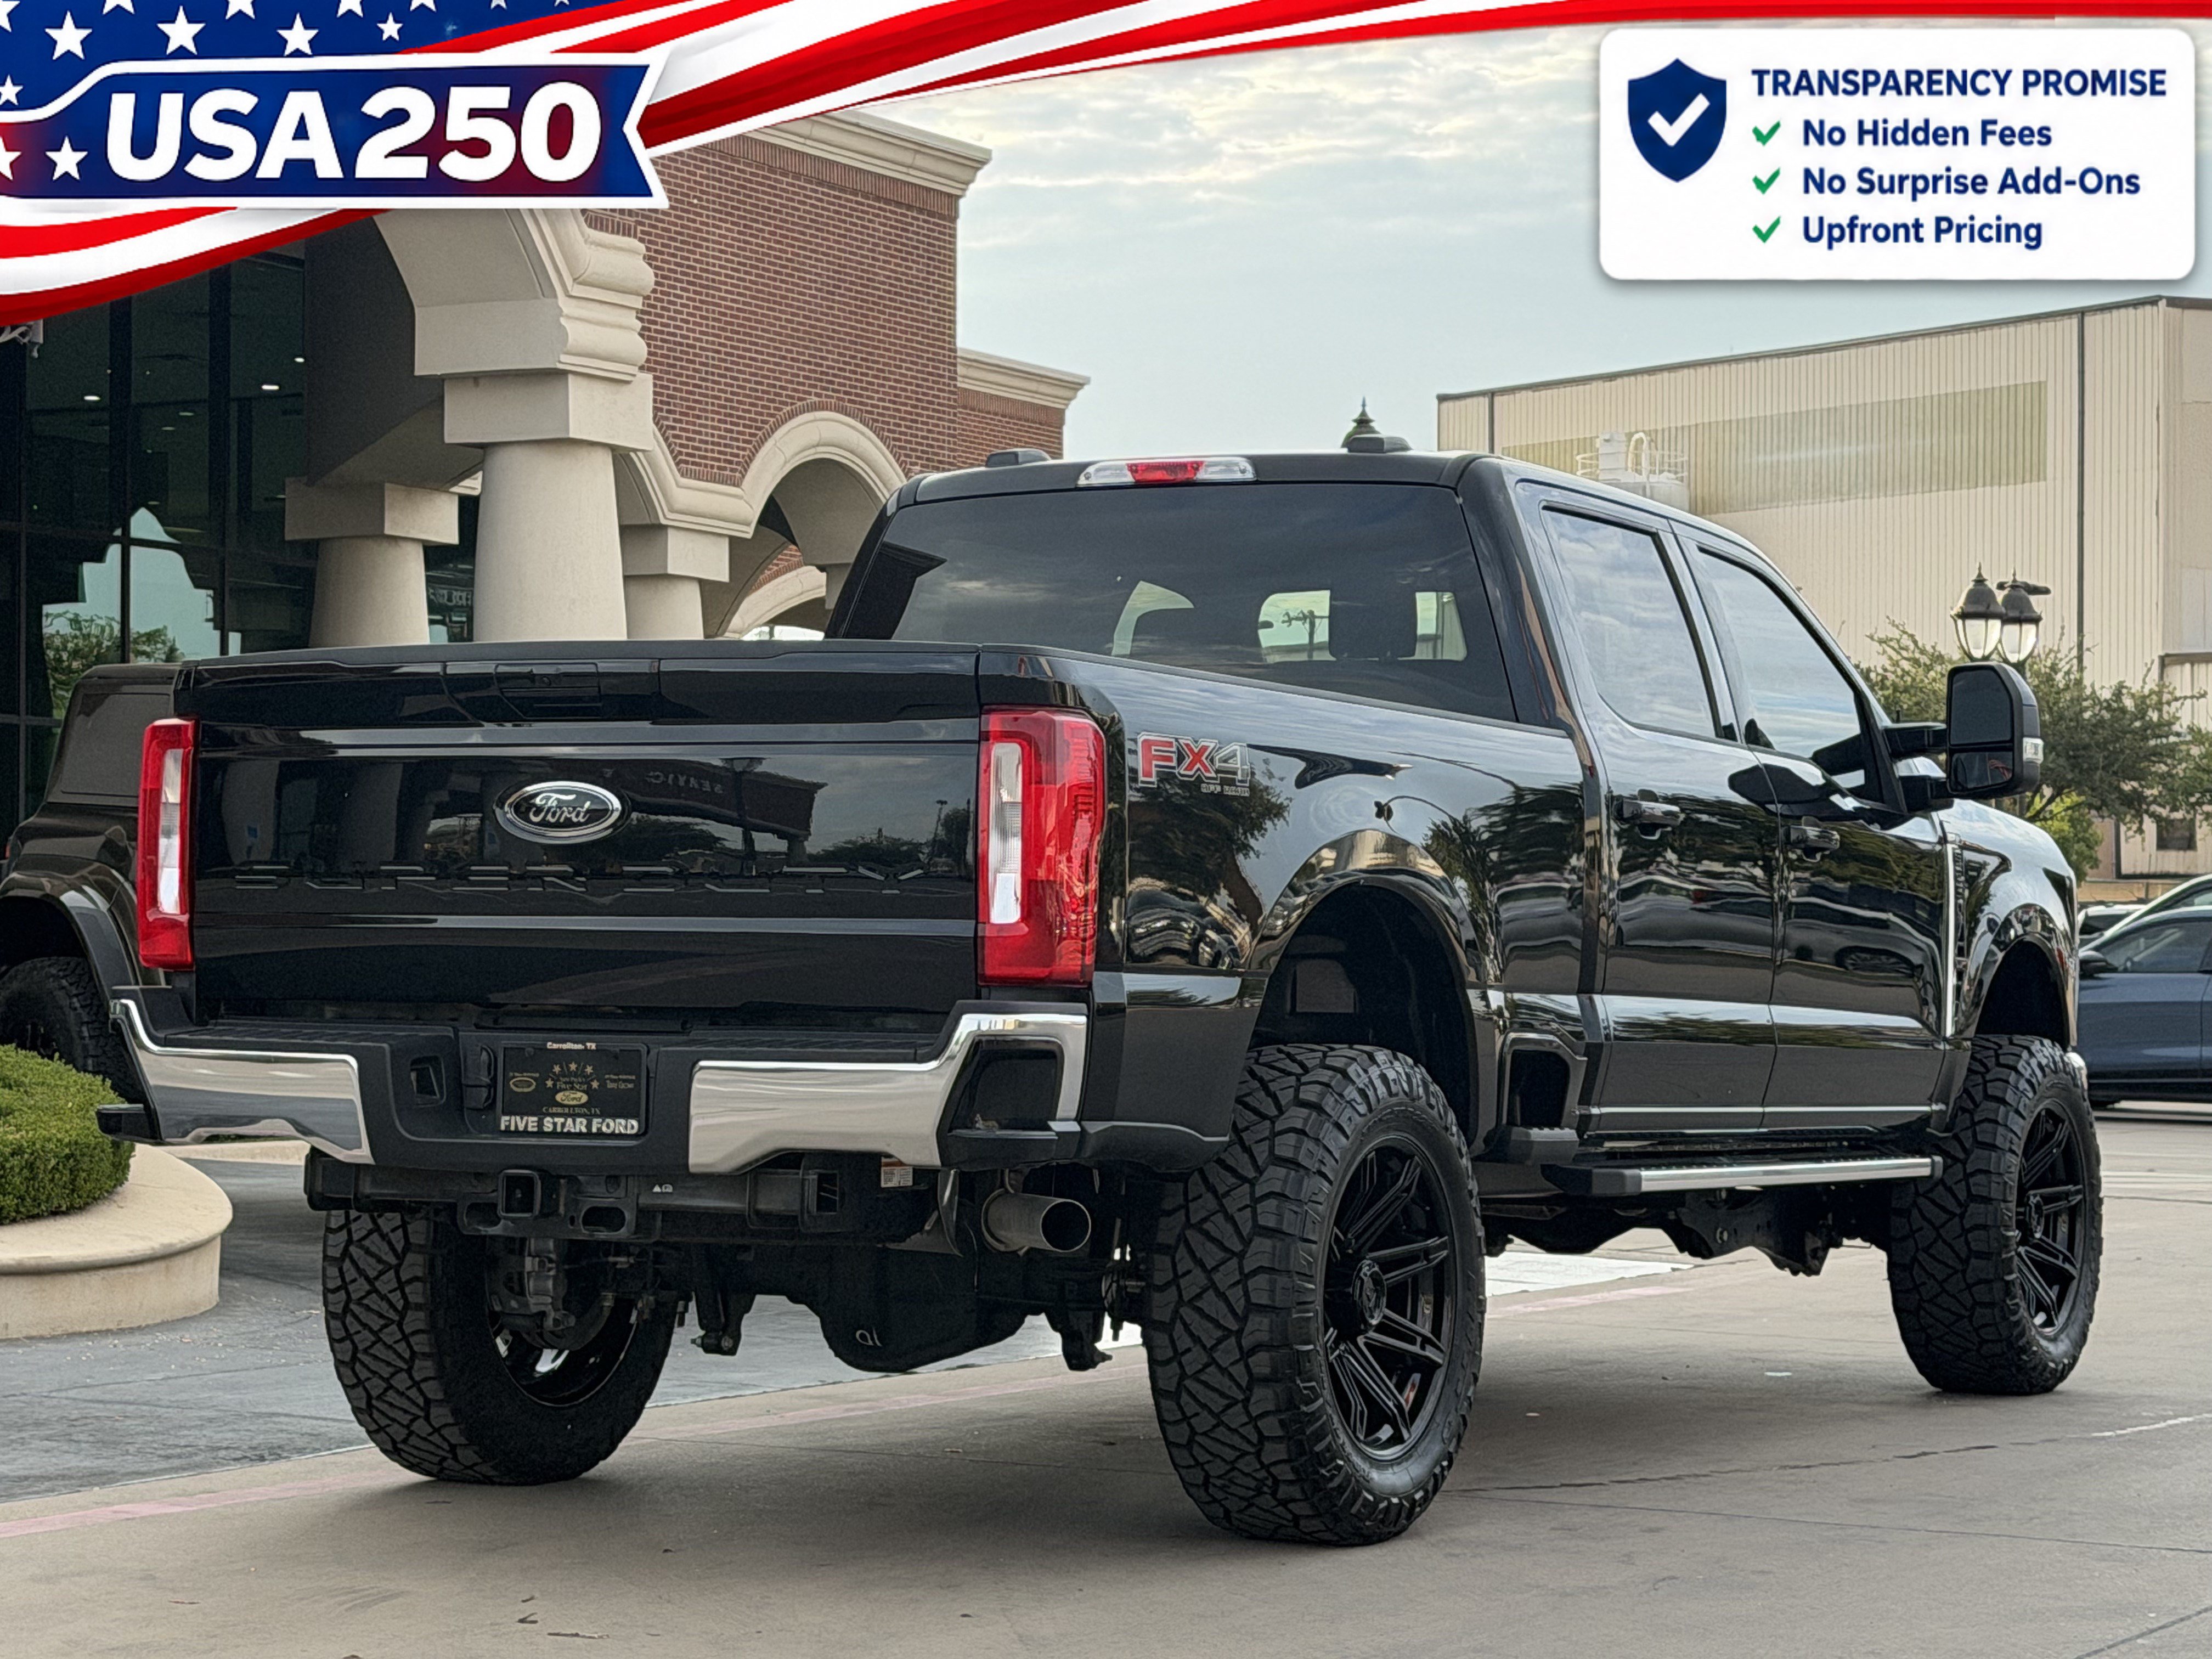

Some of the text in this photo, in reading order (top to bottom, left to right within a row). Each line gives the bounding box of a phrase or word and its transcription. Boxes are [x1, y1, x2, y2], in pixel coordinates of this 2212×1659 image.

[1138, 732, 1250, 787] FX4
[529, 793, 591, 823] Ford
[500, 1115, 639, 1135] FIVE STAR FORD
